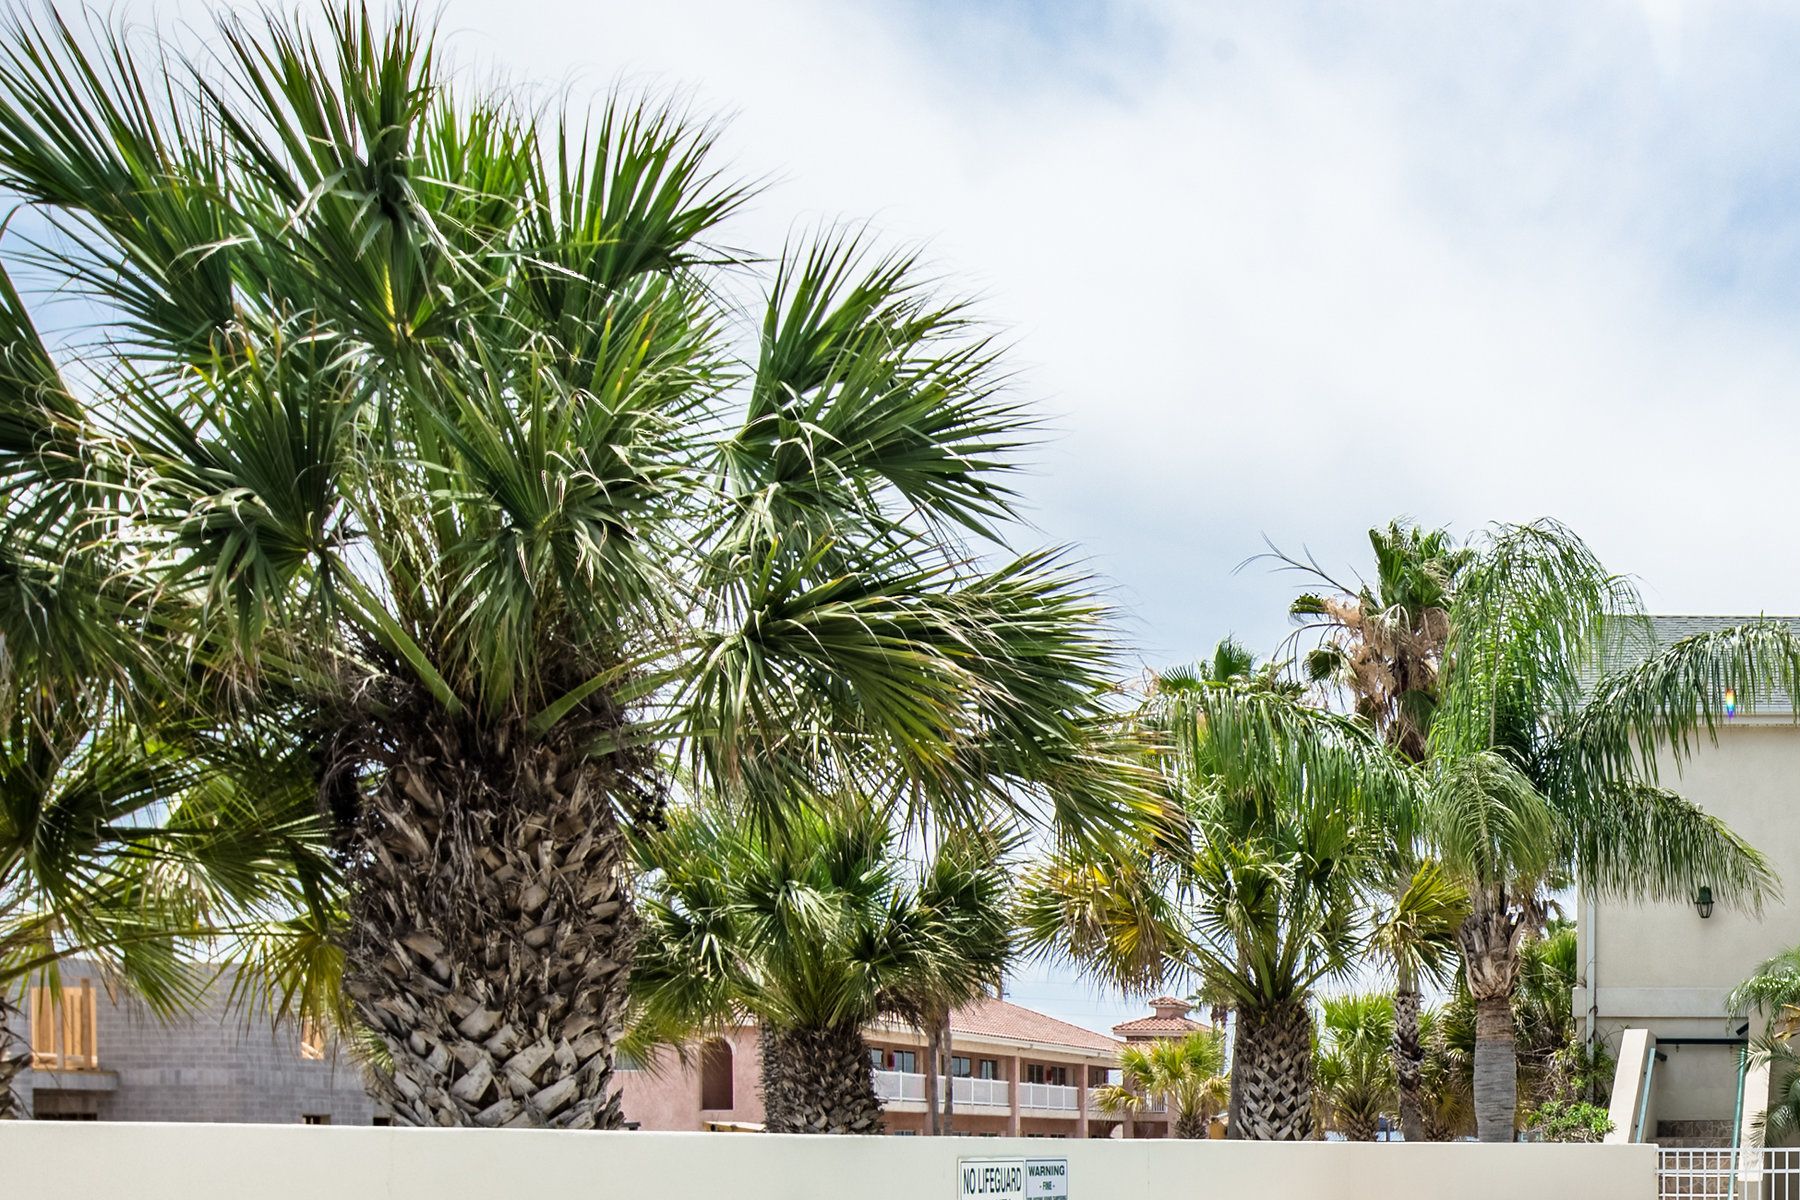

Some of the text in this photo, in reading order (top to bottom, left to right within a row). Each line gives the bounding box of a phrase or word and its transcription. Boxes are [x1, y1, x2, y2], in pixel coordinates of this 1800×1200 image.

[1027, 1165, 1065, 1176] WARNING
[963, 1167, 1022, 1194] NO LIFEGUARD
